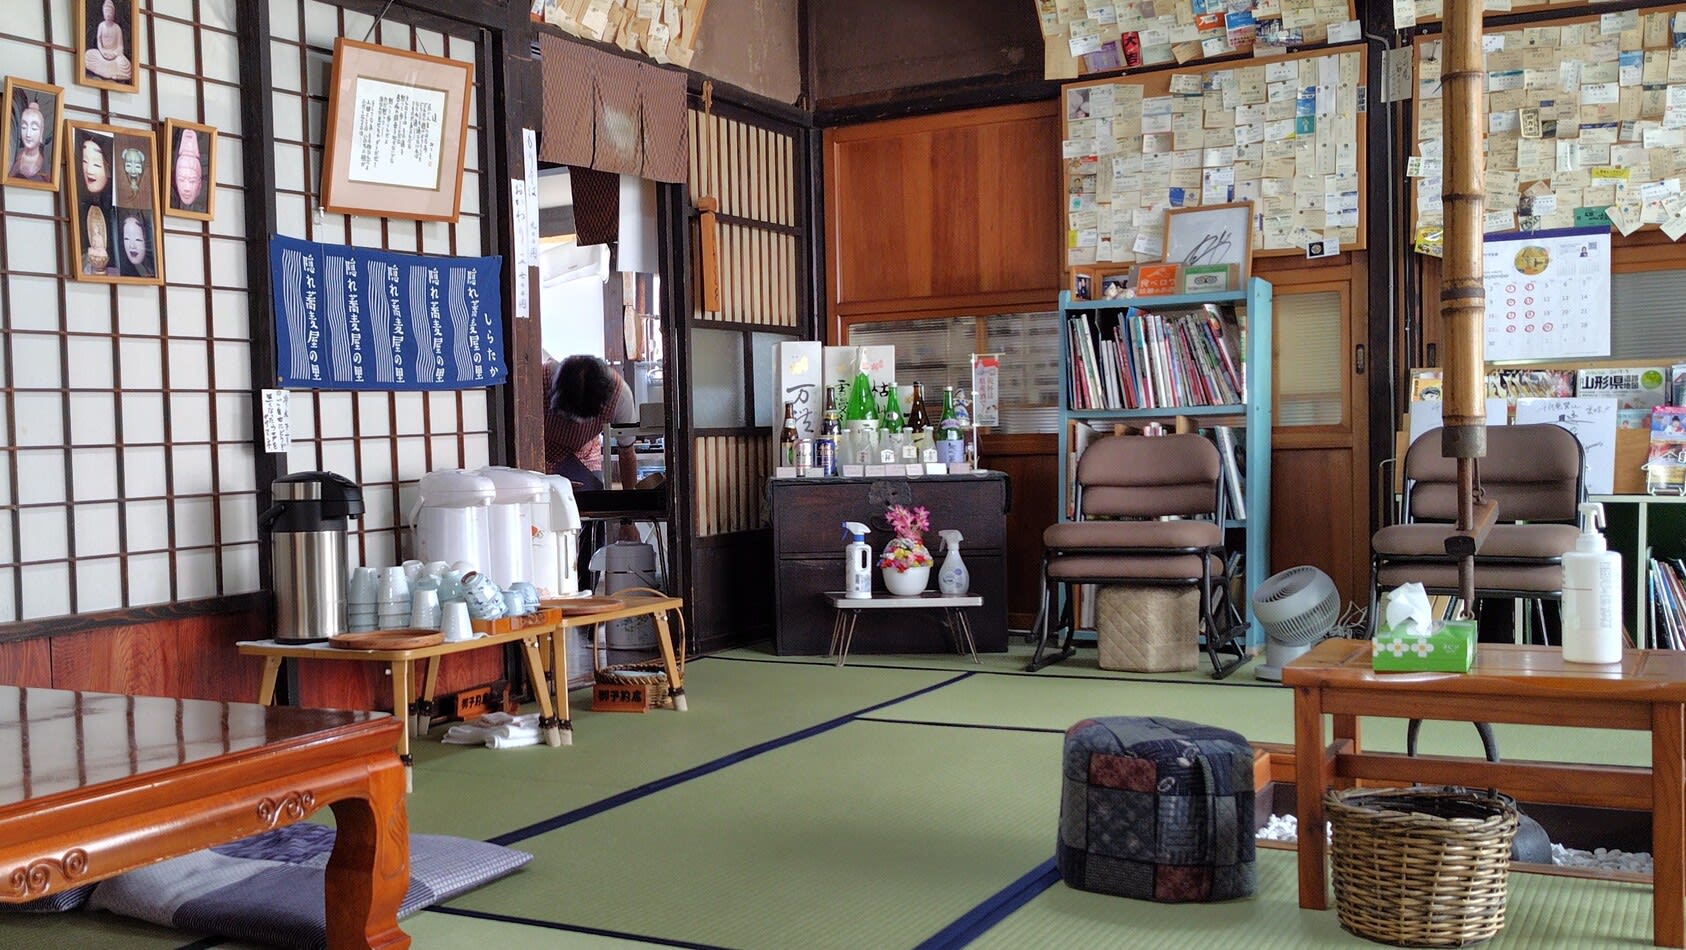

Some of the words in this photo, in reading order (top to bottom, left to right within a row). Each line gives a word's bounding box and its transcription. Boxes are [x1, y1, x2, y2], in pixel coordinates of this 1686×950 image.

[303, 254, 322, 381] 隠れ蕎麦屋の里
[345, 257, 364, 382] 隠れ蕎麦屋の里
[388, 264, 405, 383] 隠れ蕎麦屋の里
[428, 268, 444, 383] 隠れ蕎麦屋の里
[467, 268, 484, 380] 隠れ蕎麦屋の里
[484, 313, 498, 378] しらたか
[1582, 376, 1623, 389] 山形県
